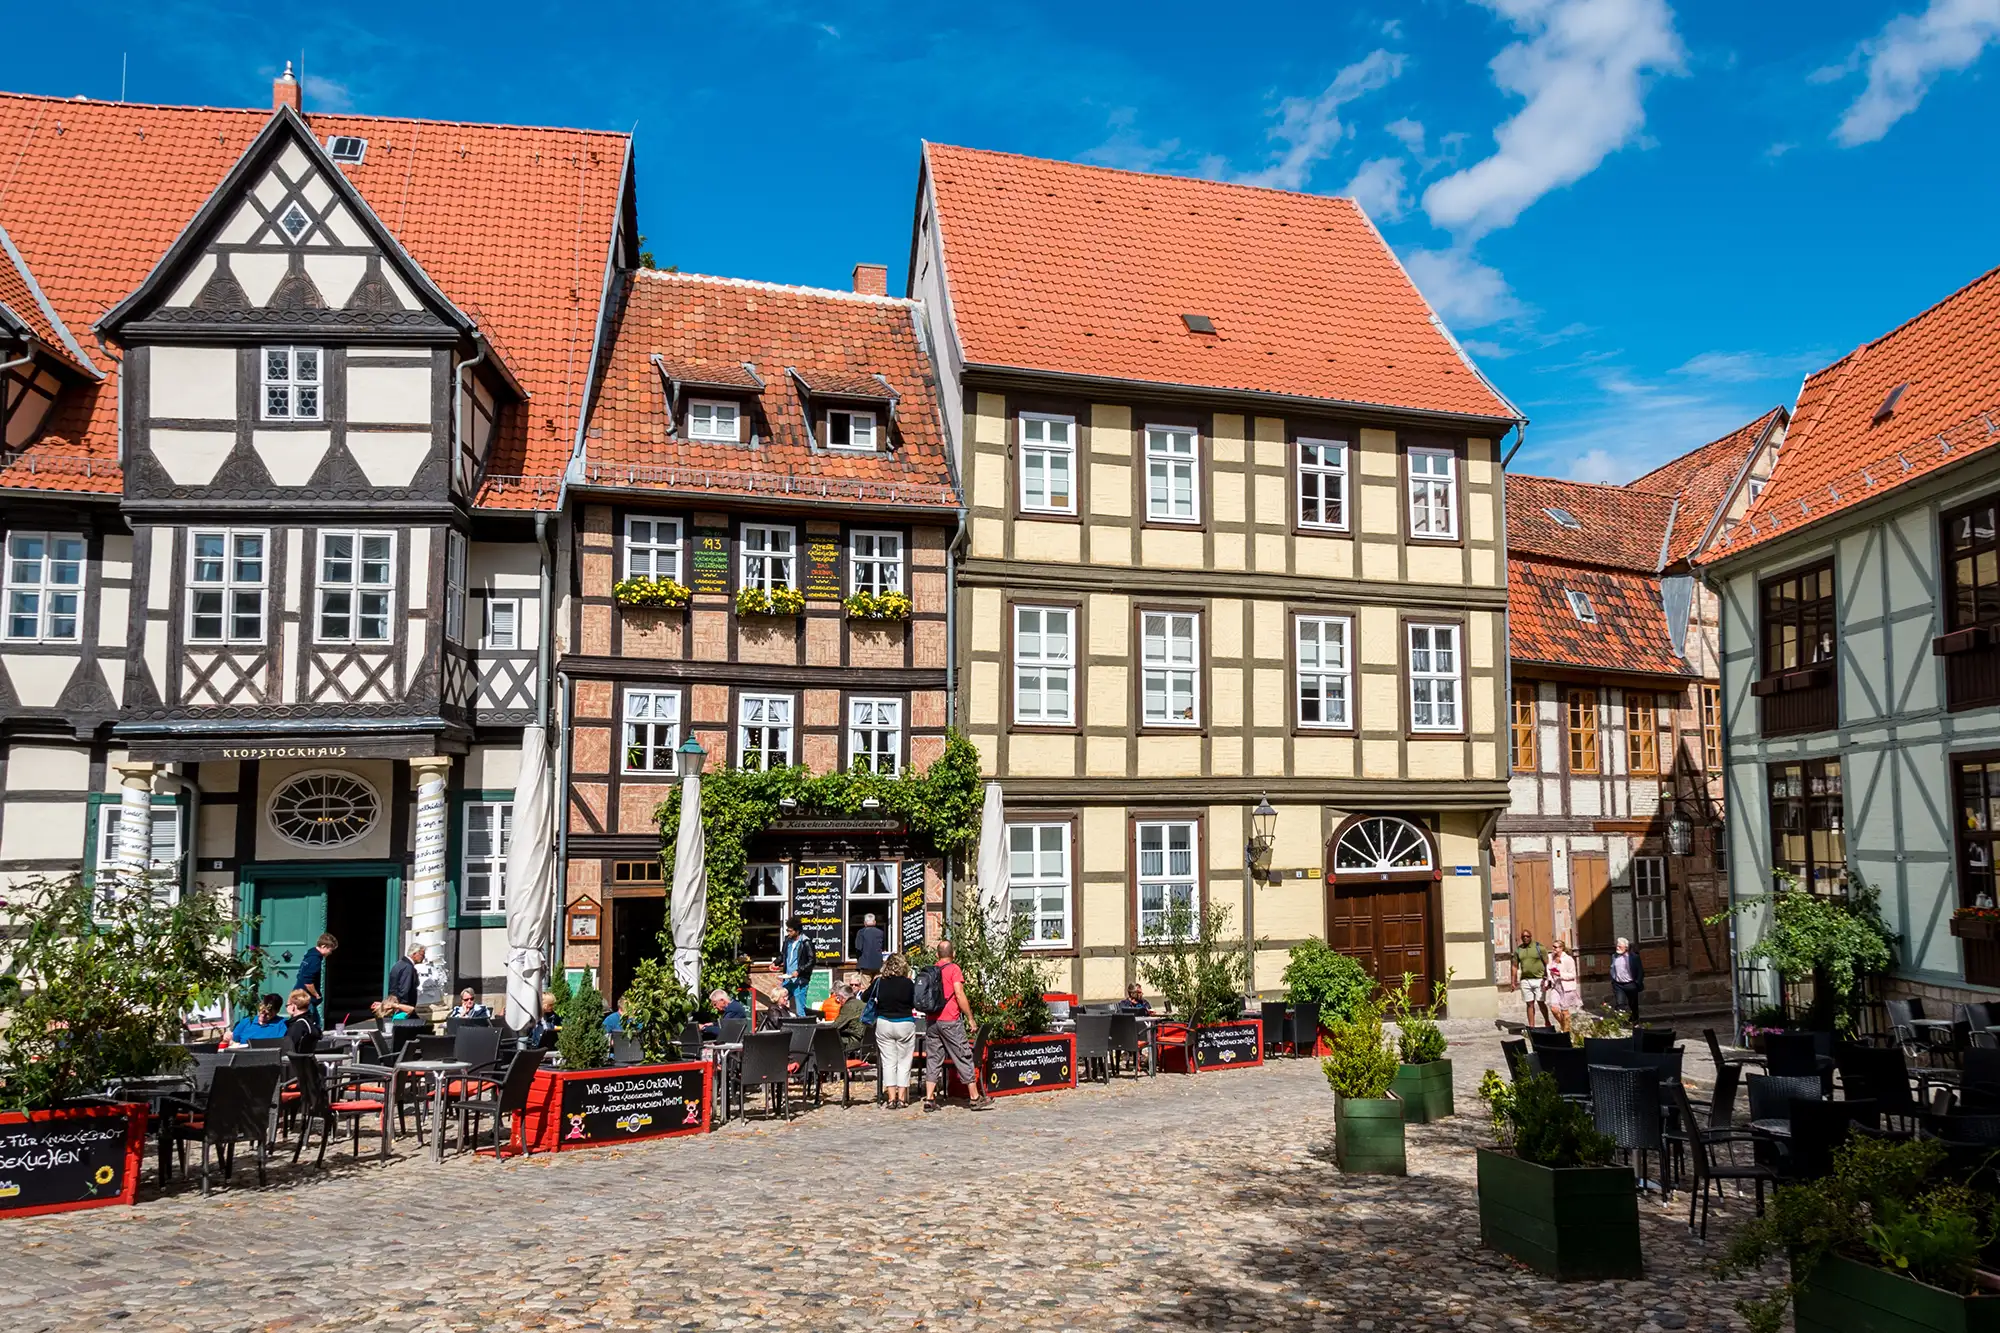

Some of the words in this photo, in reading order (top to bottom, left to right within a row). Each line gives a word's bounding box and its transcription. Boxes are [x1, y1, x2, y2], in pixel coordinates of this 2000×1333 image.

[703, 538, 721, 550] 193
[223, 747, 346, 759] KLOPSTOCKHAUS
[786, 820, 887, 828] Käsekuchenbäckerei
[1022, 1048, 1045, 1056] UNSERER
[586, 1084, 602, 1095] WIR
[604, 1082, 624, 1093] SIND
[626, 1080, 645, 1091] DAS
[586, 1105, 600, 1114] DIE
[601, 1103, 635, 1113] ANDEREN
[6, 1133, 38, 1147] FÜR
